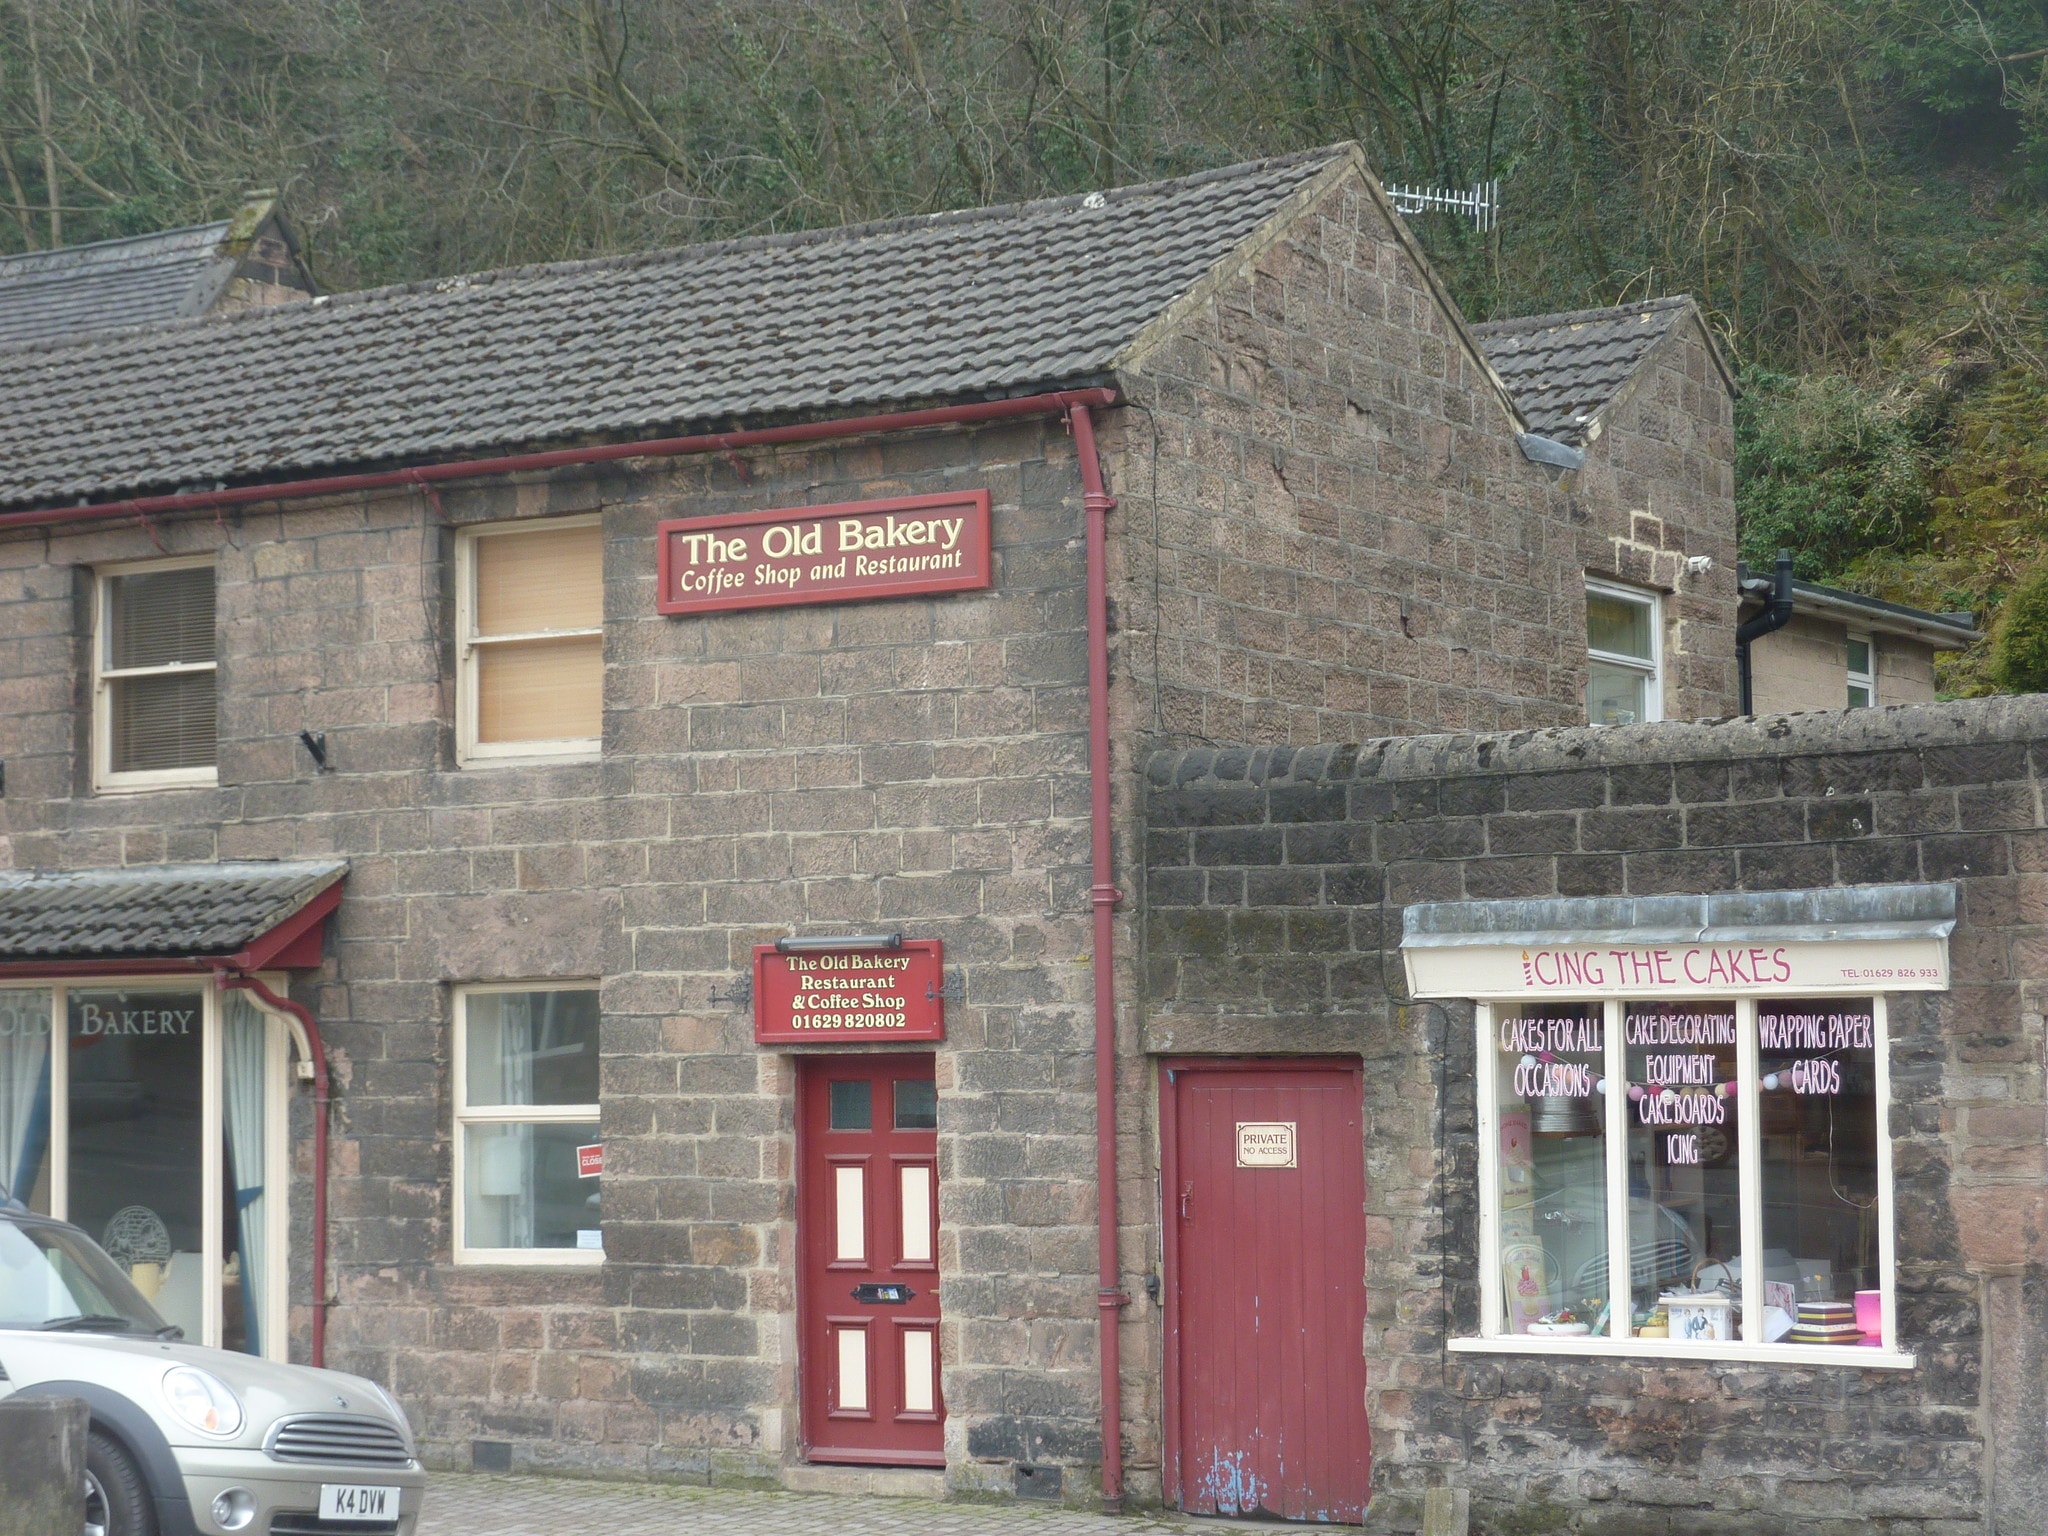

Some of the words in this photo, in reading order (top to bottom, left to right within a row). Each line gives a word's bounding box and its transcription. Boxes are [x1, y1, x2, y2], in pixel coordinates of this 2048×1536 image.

[682, 532, 748, 565] The
[762, 523, 823, 558] Old
[838, 516, 964, 550] Bakery
[681, 568, 745, 594] Coffee
[754, 563, 801, 588] Shop
[810, 557, 846, 580] and
[855, 549, 963, 577] Restaurant
[786, 956, 817, 971] The
[820, 955, 849, 970] Old
[851, 954, 910, 971] Bakery
[1609, 950, 1676, 985] THE
[1683, 947, 1791, 984] CAKES
[1897, 969, 1916, 978] 826
[1919, 968, 1939, 978] 933
[801, 975, 895, 990] Restaurant
[792, 995, 805, 1010] &
[808, 993, 859, 1010] Coffee
[862, 992, 906, 1010] Shop
[80, 1003, 195, 1035] BAKERY
[792, 1013, 842, 1029] 01629
[845, 1013, 906, 1028] 820802
[1501, 1018, 1545, 1052] CAKES
[1547, 1018, 1575, 1052] FOR
[1577, 1017, 1602, 1052] ALL
[1625, 1015, 1657, 1045] CAKE
[1660, 1014, 1735, 1044] DECORATING
[1759, 1014, 1826, 1049] WRAPPING
[1828, 1013, 1872, 1048] PAPER
[1514, 1062, 1591, 1097] OCCASIONS
[1646, 1054, 1715, 1085] EQUIPMENT
[1792, 1059, 1840, 1095] CARDS
[1639, 1094, 1672, 1125] CAKE
[1674, 1094, 1724, 1124] BOARDS
[1243, 1134, 1287, 1144] PRIVATE
[1667, 1134, 1698, 1164] ICING
[336, 1488, 355, 1514] K4
[359, 1489, 386, 1515] DVW
